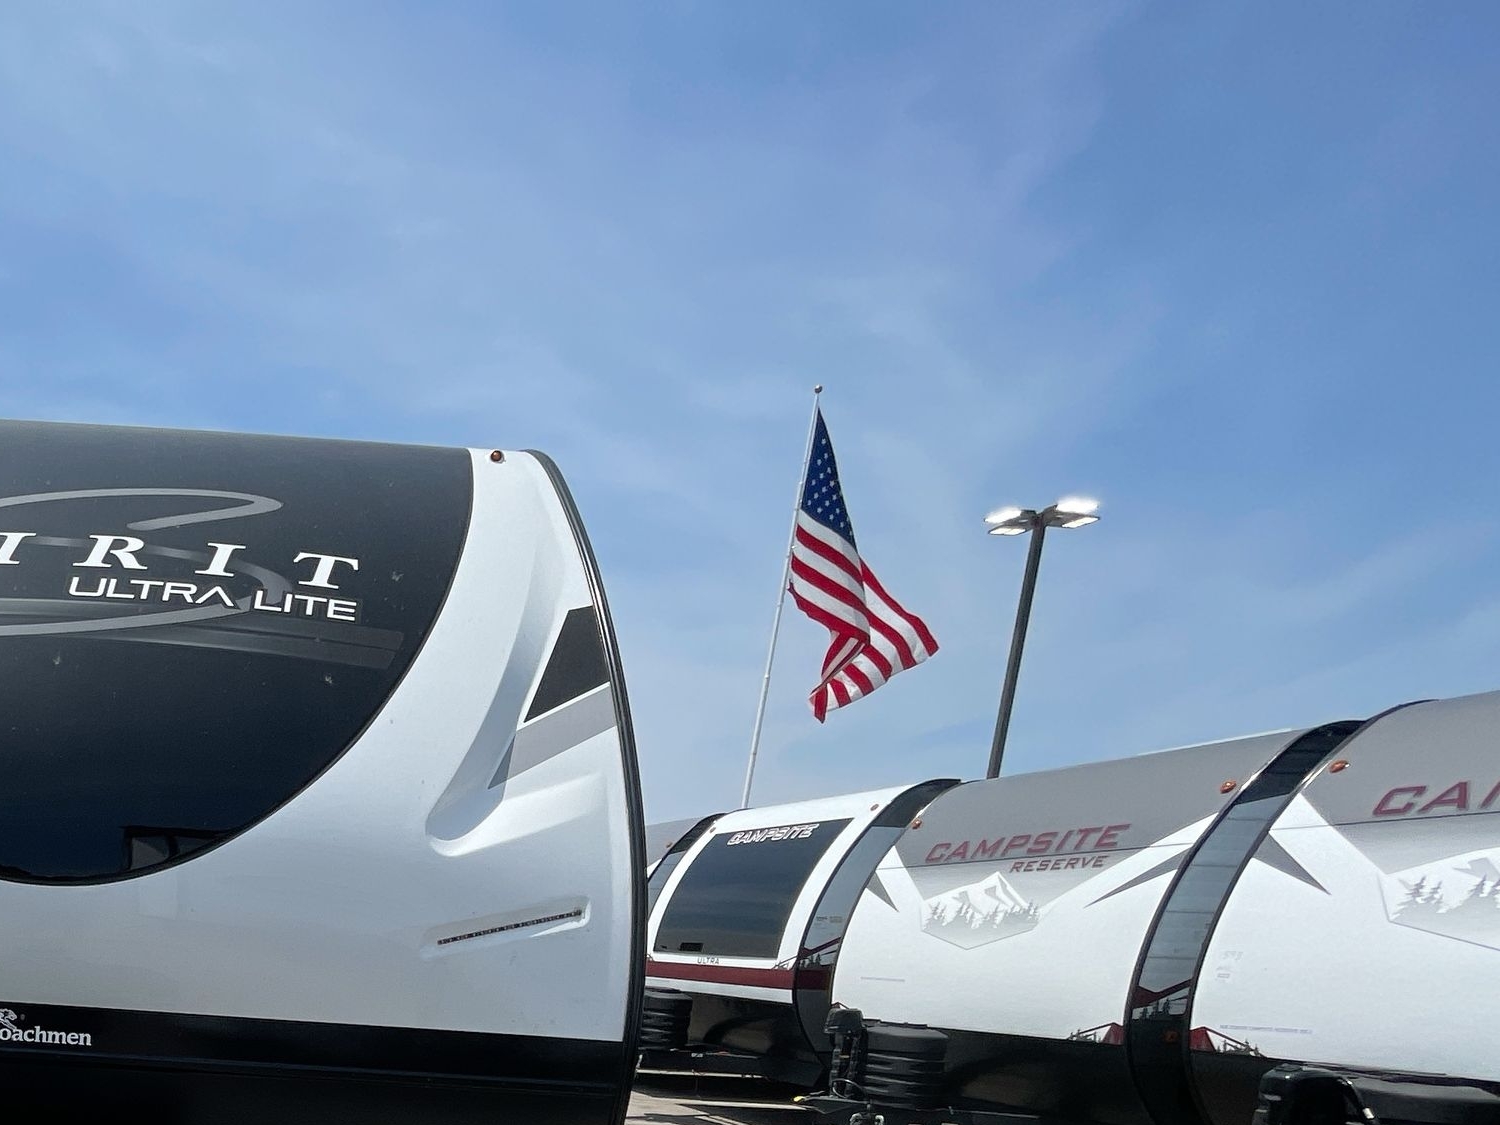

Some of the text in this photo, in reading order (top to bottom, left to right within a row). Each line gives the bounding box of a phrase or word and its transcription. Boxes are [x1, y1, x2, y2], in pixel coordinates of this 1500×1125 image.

[68, 576, 358, 621] ULTRA LITE
[727, 823, 820, 846] CAMPSITE
[925, 823, 1132, 864] CAMPSITE
[1009, 855, 1110, 873] RESERVE
[697, 957, 720, 965] ULTRA
